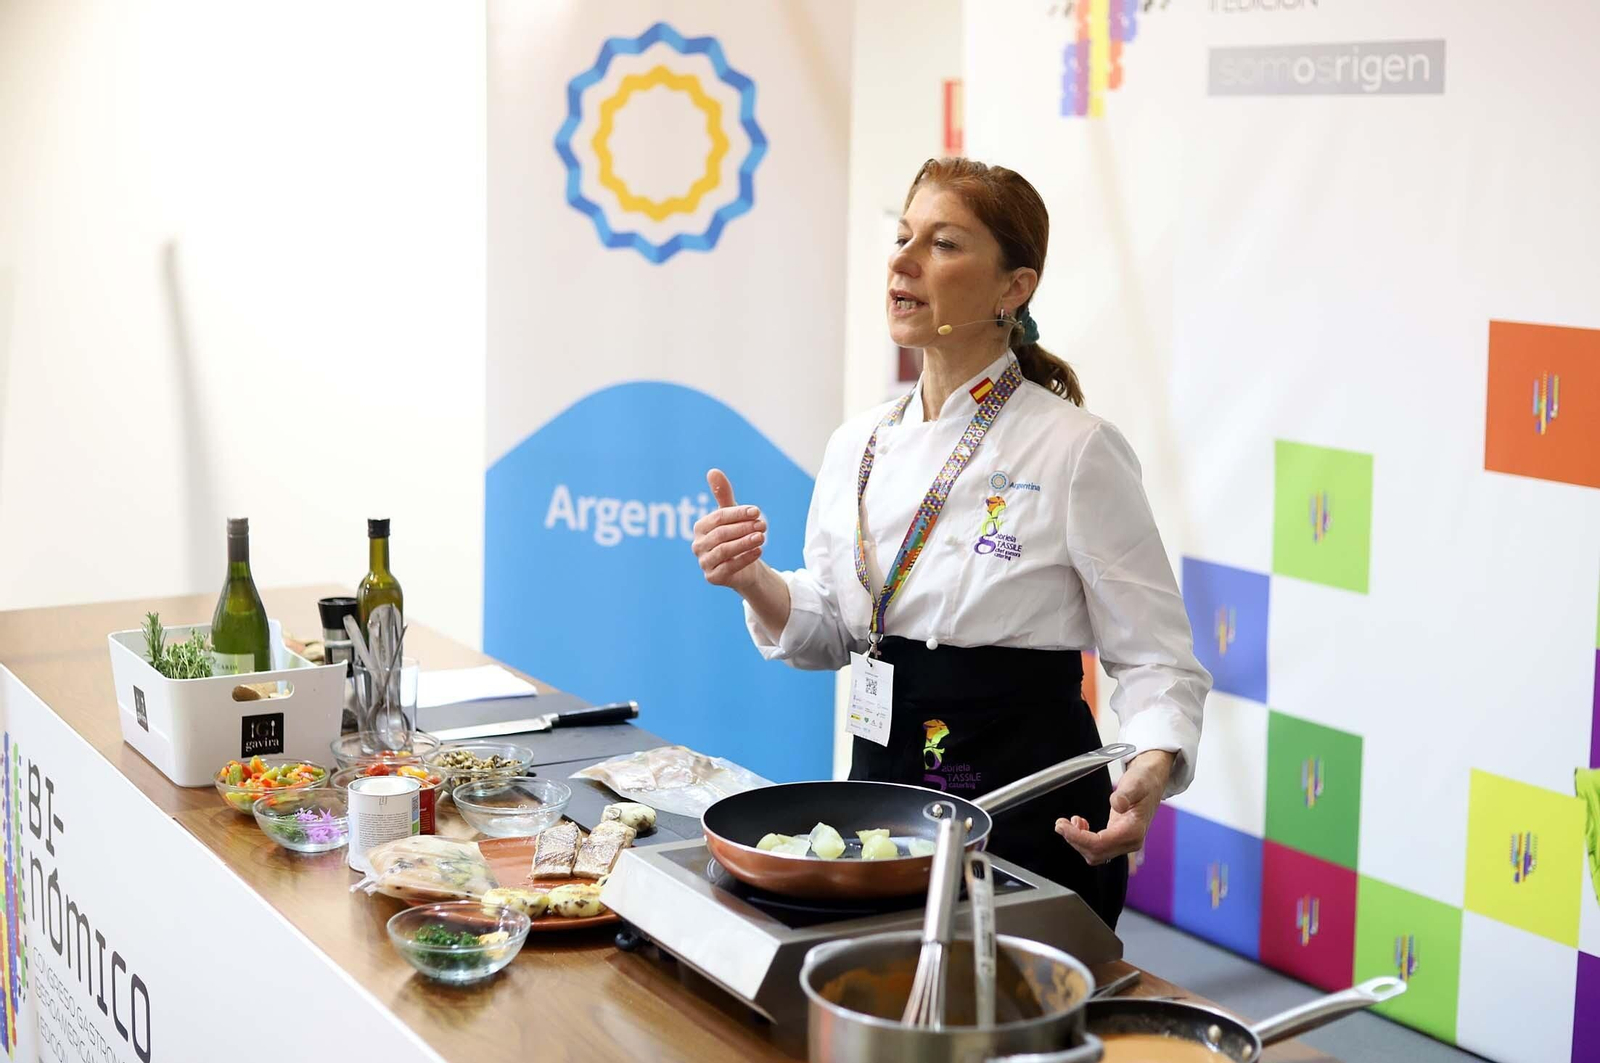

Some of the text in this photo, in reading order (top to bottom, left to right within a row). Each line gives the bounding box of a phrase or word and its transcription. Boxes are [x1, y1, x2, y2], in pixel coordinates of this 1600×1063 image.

[1009, 481, 1041, 492] Argentina
[545, 484, 768, 547] Argenti
[245, 737, 280, 753] gavira
[946, 772, 981, 782] TASSILE
